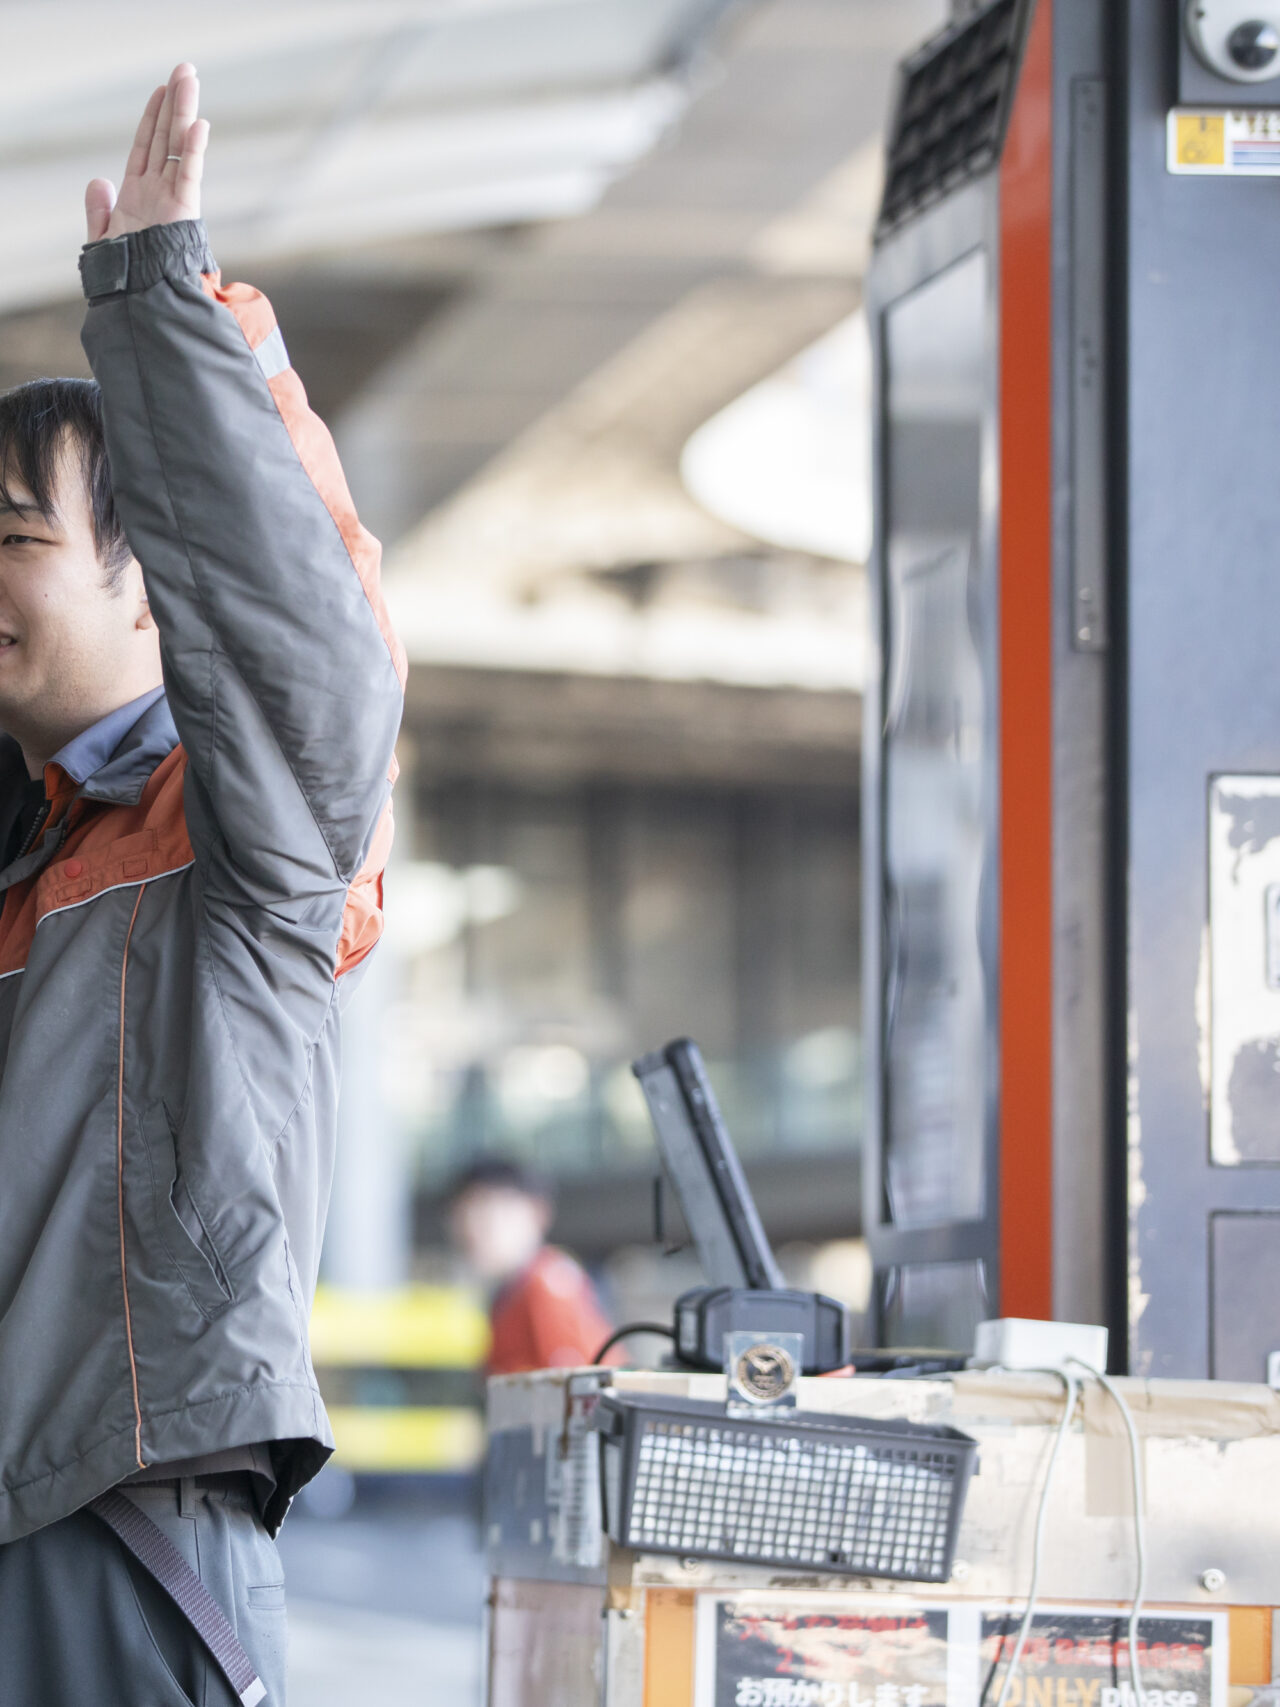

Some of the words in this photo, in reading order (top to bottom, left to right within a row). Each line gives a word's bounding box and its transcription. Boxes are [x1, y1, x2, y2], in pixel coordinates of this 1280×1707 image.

[734, 1676, 929, 1707] お預かりします
[992, 1676, 1101, 1707] ONLY
